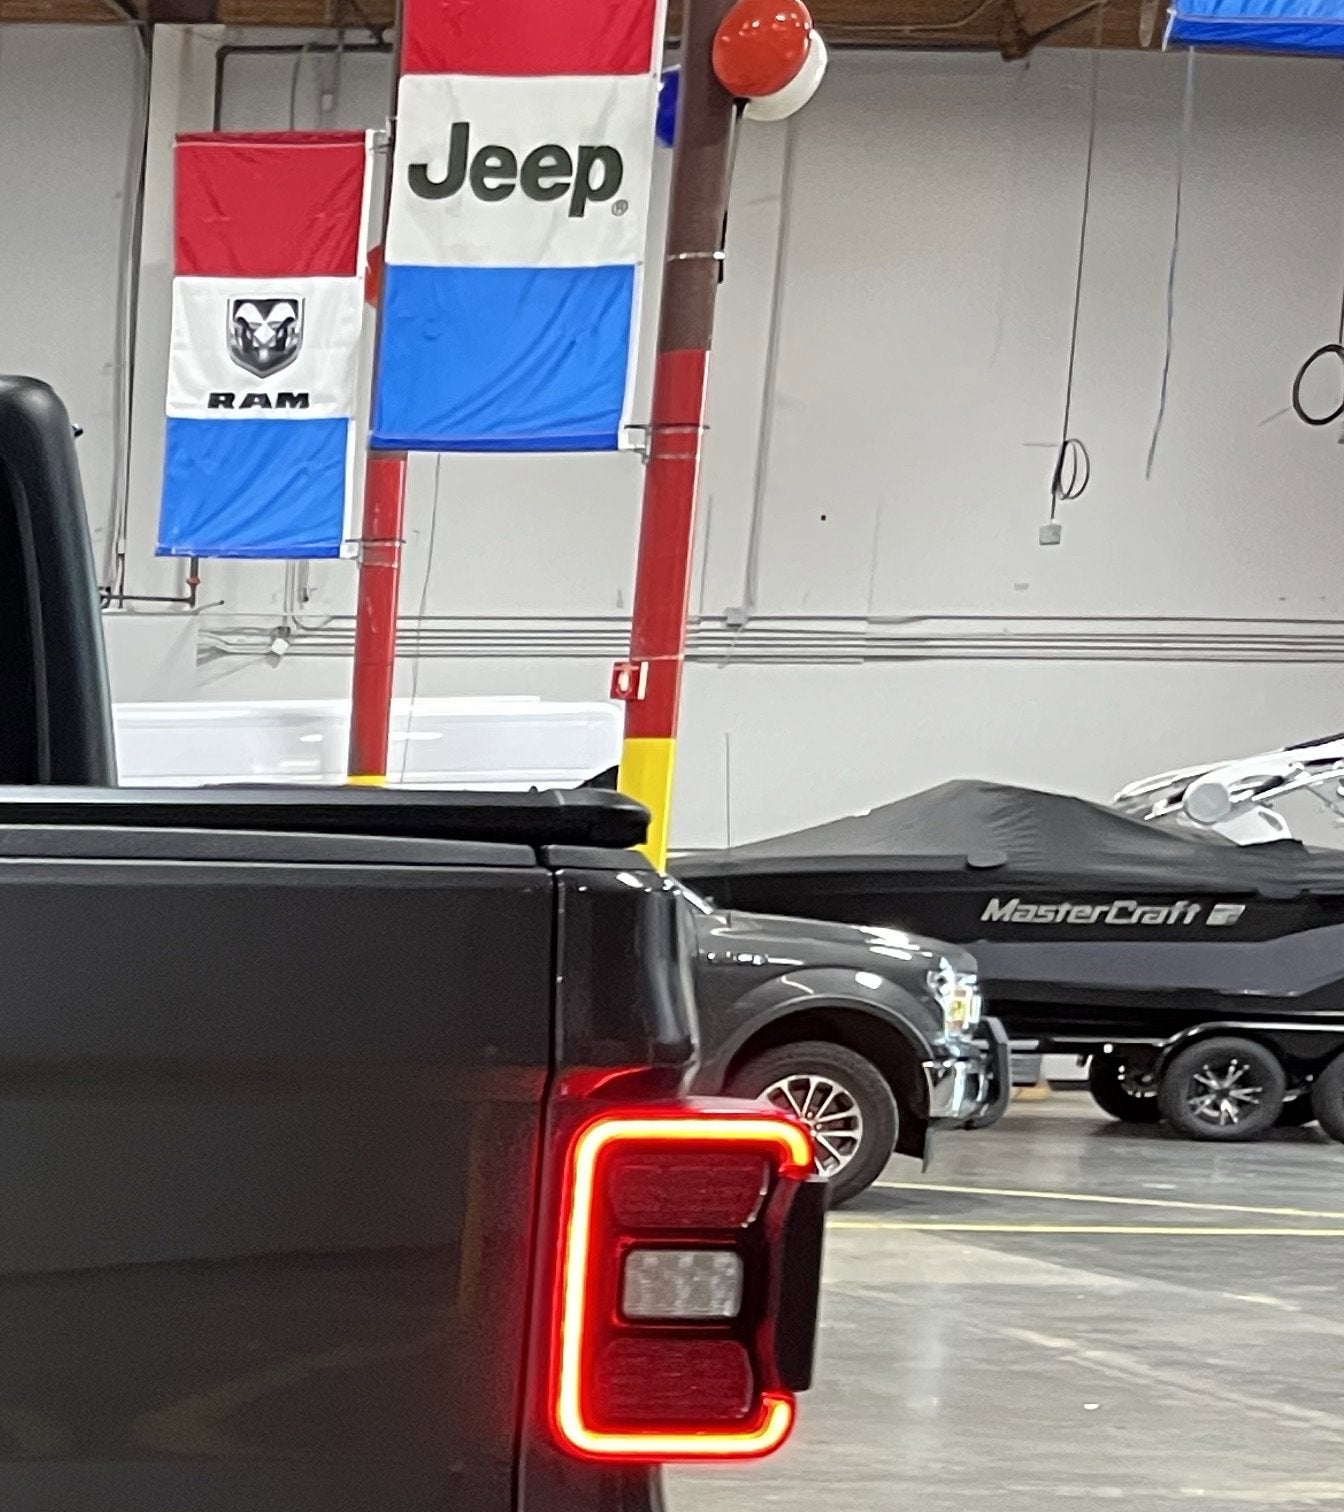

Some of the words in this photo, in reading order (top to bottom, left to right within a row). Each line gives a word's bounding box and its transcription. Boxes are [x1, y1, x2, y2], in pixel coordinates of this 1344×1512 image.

[407, 122, 624, 218] Jeep
[207, 391, 310, 410] RAM
[980, 897, 1201, 925] MasterCraft
